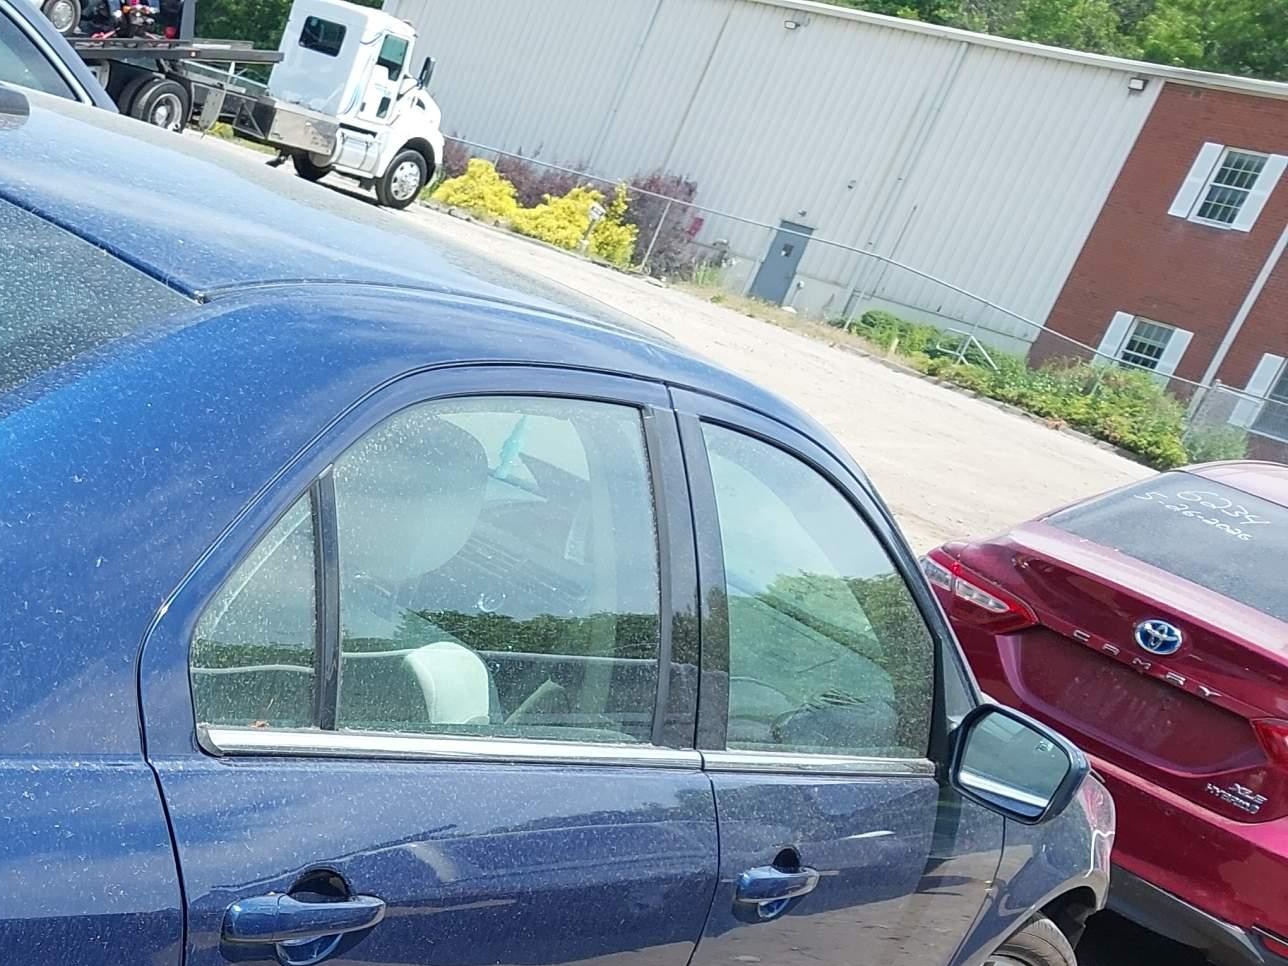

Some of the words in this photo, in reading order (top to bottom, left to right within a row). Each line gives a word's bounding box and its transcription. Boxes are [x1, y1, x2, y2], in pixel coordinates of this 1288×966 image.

[1176, 490, 1272, 525] 6234
[1073, 629, 1223, 697] CAMRY
[1228, 783, 1269, 804] XLE
